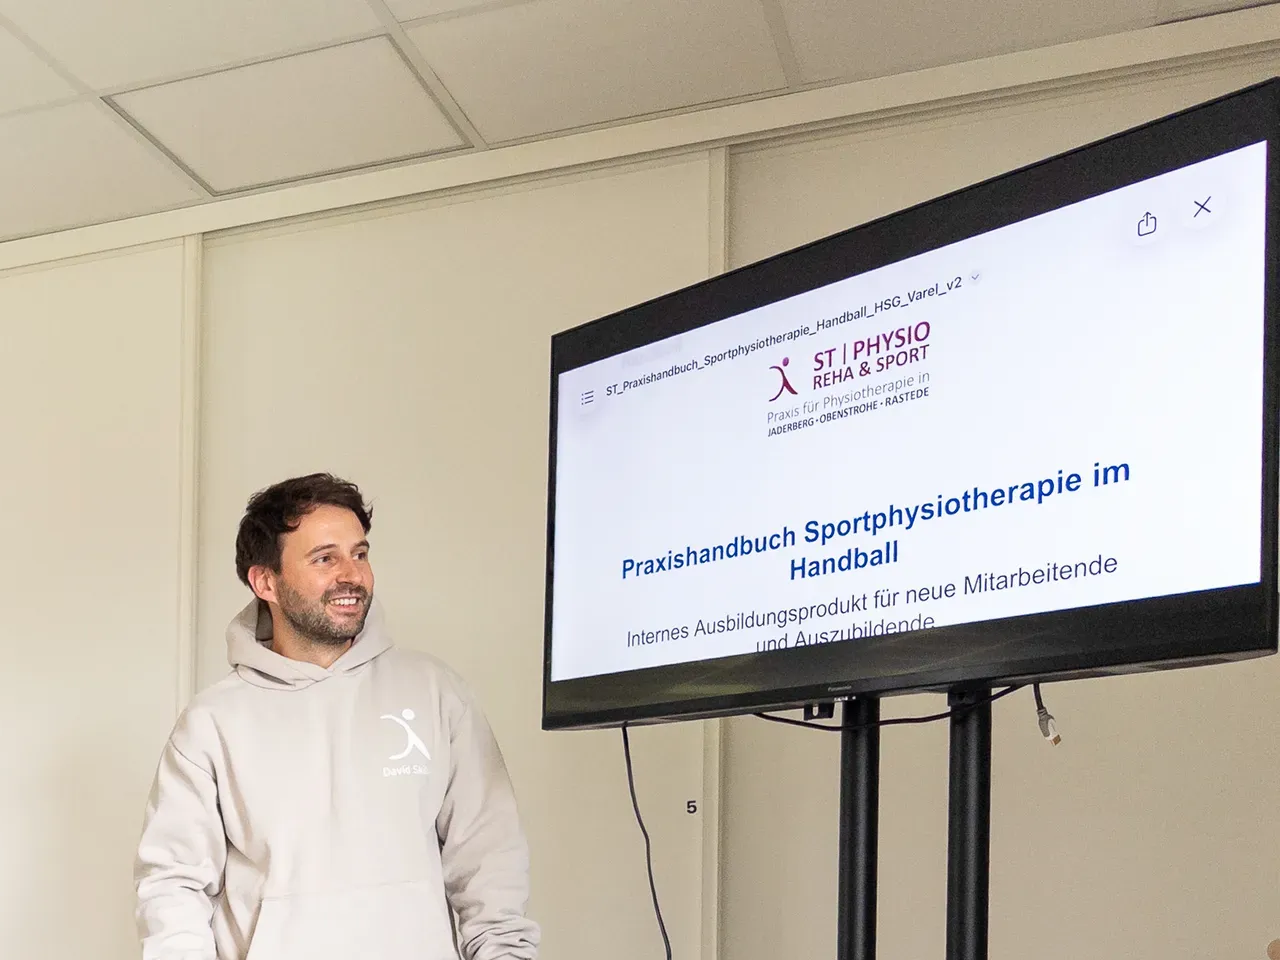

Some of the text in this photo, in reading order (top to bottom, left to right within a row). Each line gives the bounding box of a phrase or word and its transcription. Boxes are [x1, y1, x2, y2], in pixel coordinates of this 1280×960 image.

[606, 276, 962, 396] ST_Praxishandbuch_Sportphysiotherapie_Handball_HSG_Varel_v2
[812, 347, 837, 372] ST
[852, 320, 932, 361] PHYSIO
[812, 343, 930, 391] REHA & SPORT
[767, 371, 930, 424] Praxis für Physiotherapie in
[885, 386, 930, 407] RASTEDE
[622, 462, 1130, 580] Praxishandbuch Sportphysiotherapie im
[790, 540, 899, 581] Handball
[627, 554, 1118, 648] Internes Ausbildungsprodukt für neue Mitarbeitende
[756, 613, 936, 653] und Auszubildende
[686, 800, 697, 814] 5
